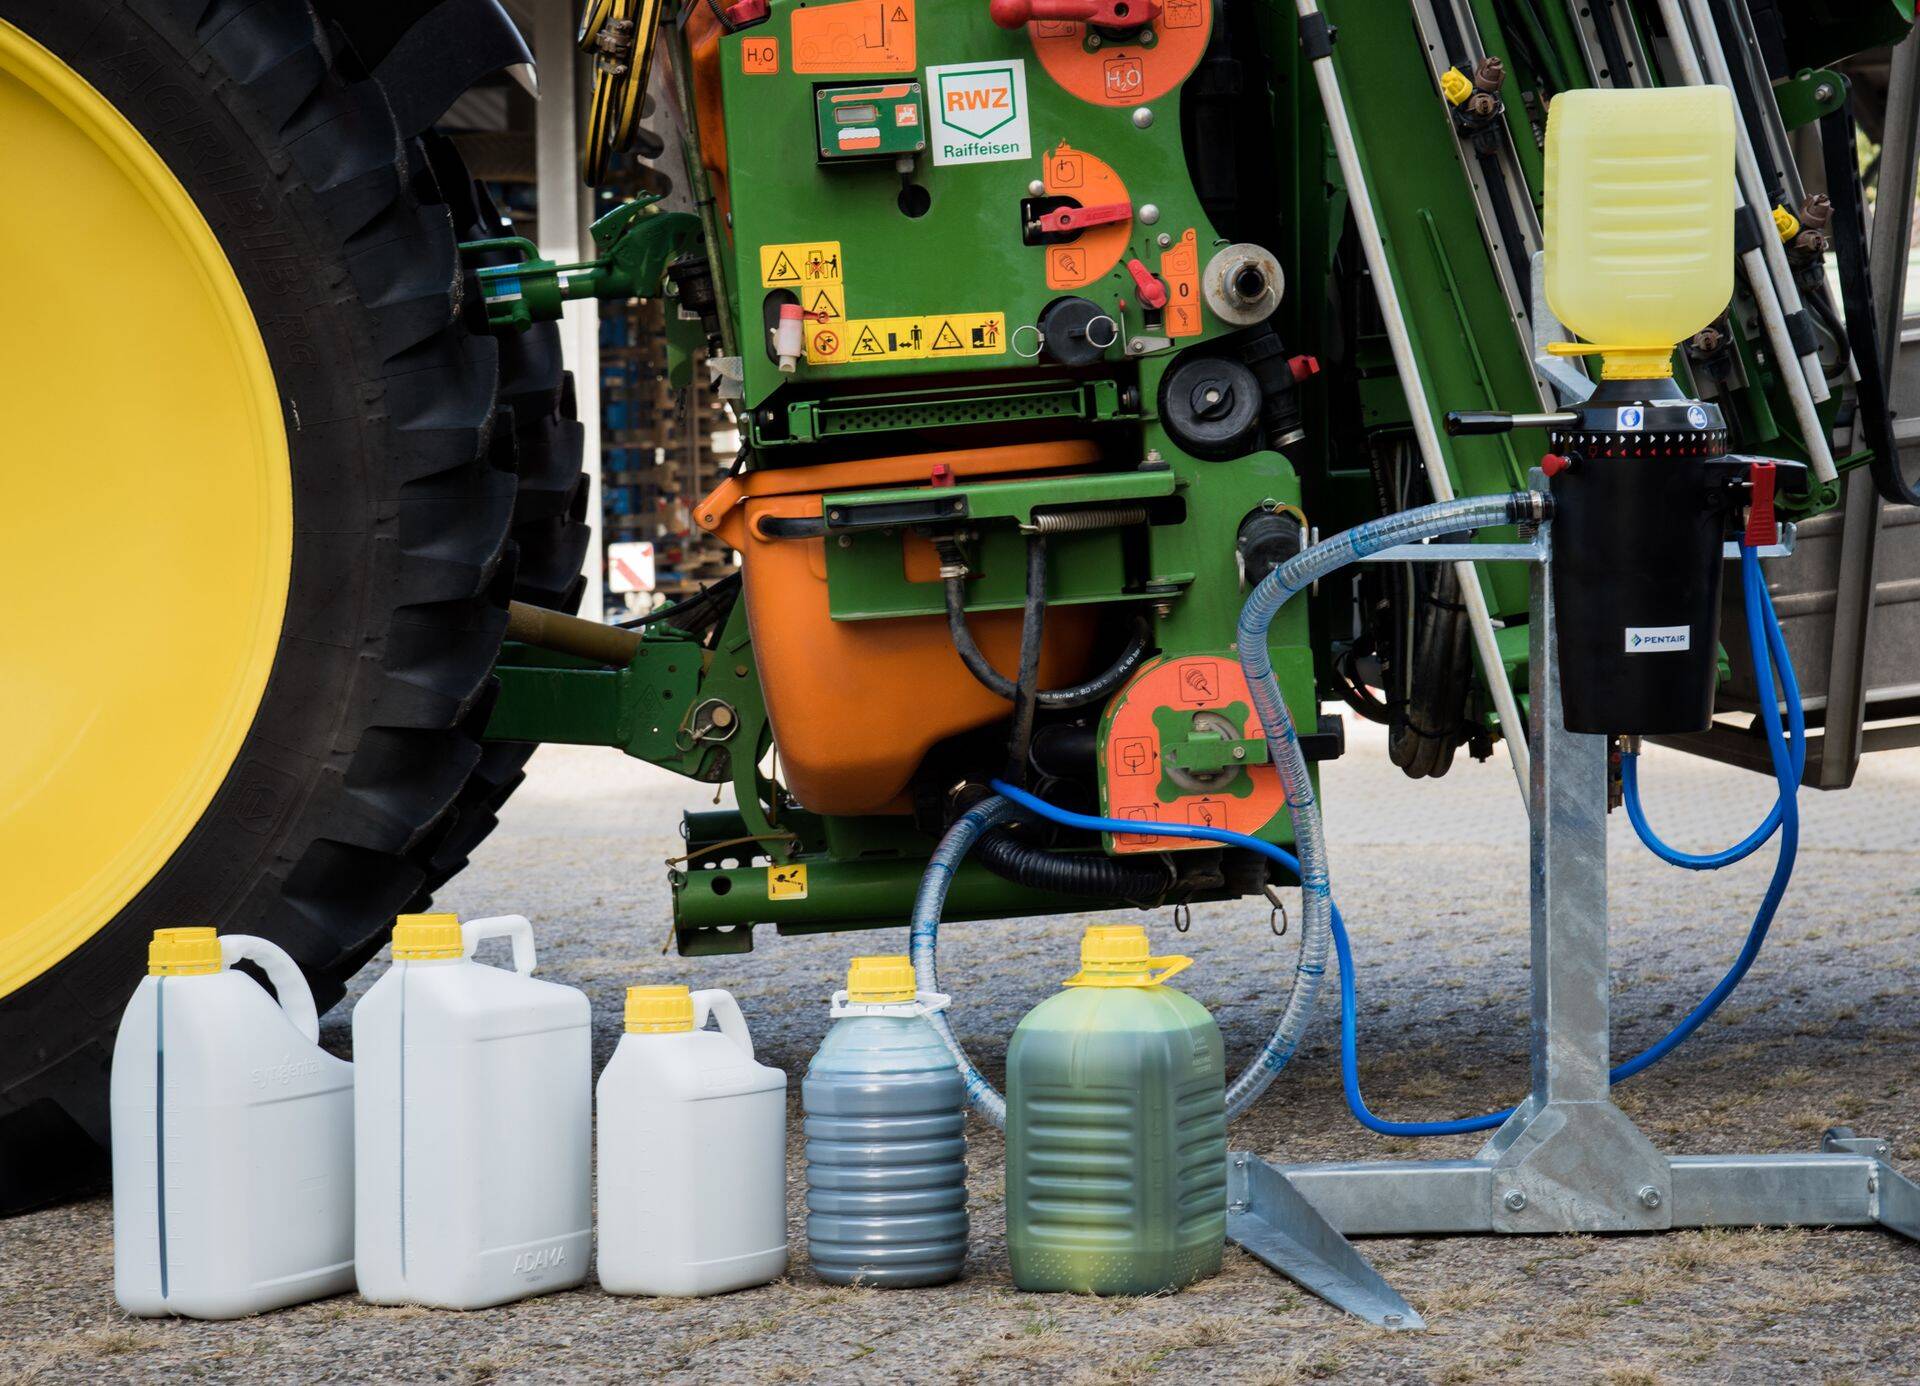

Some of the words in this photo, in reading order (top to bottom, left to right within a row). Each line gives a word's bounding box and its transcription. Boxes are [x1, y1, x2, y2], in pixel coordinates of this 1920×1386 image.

[946, 87, 1009, 112] RWZ
[943, 141, 1020, 158] Raiffeisen
[1644, 635, 1686, 644] PENTAIR
[250, 1057, 319, 1089] syngenta
[512, 1246, 568, 1275] ADAMA
